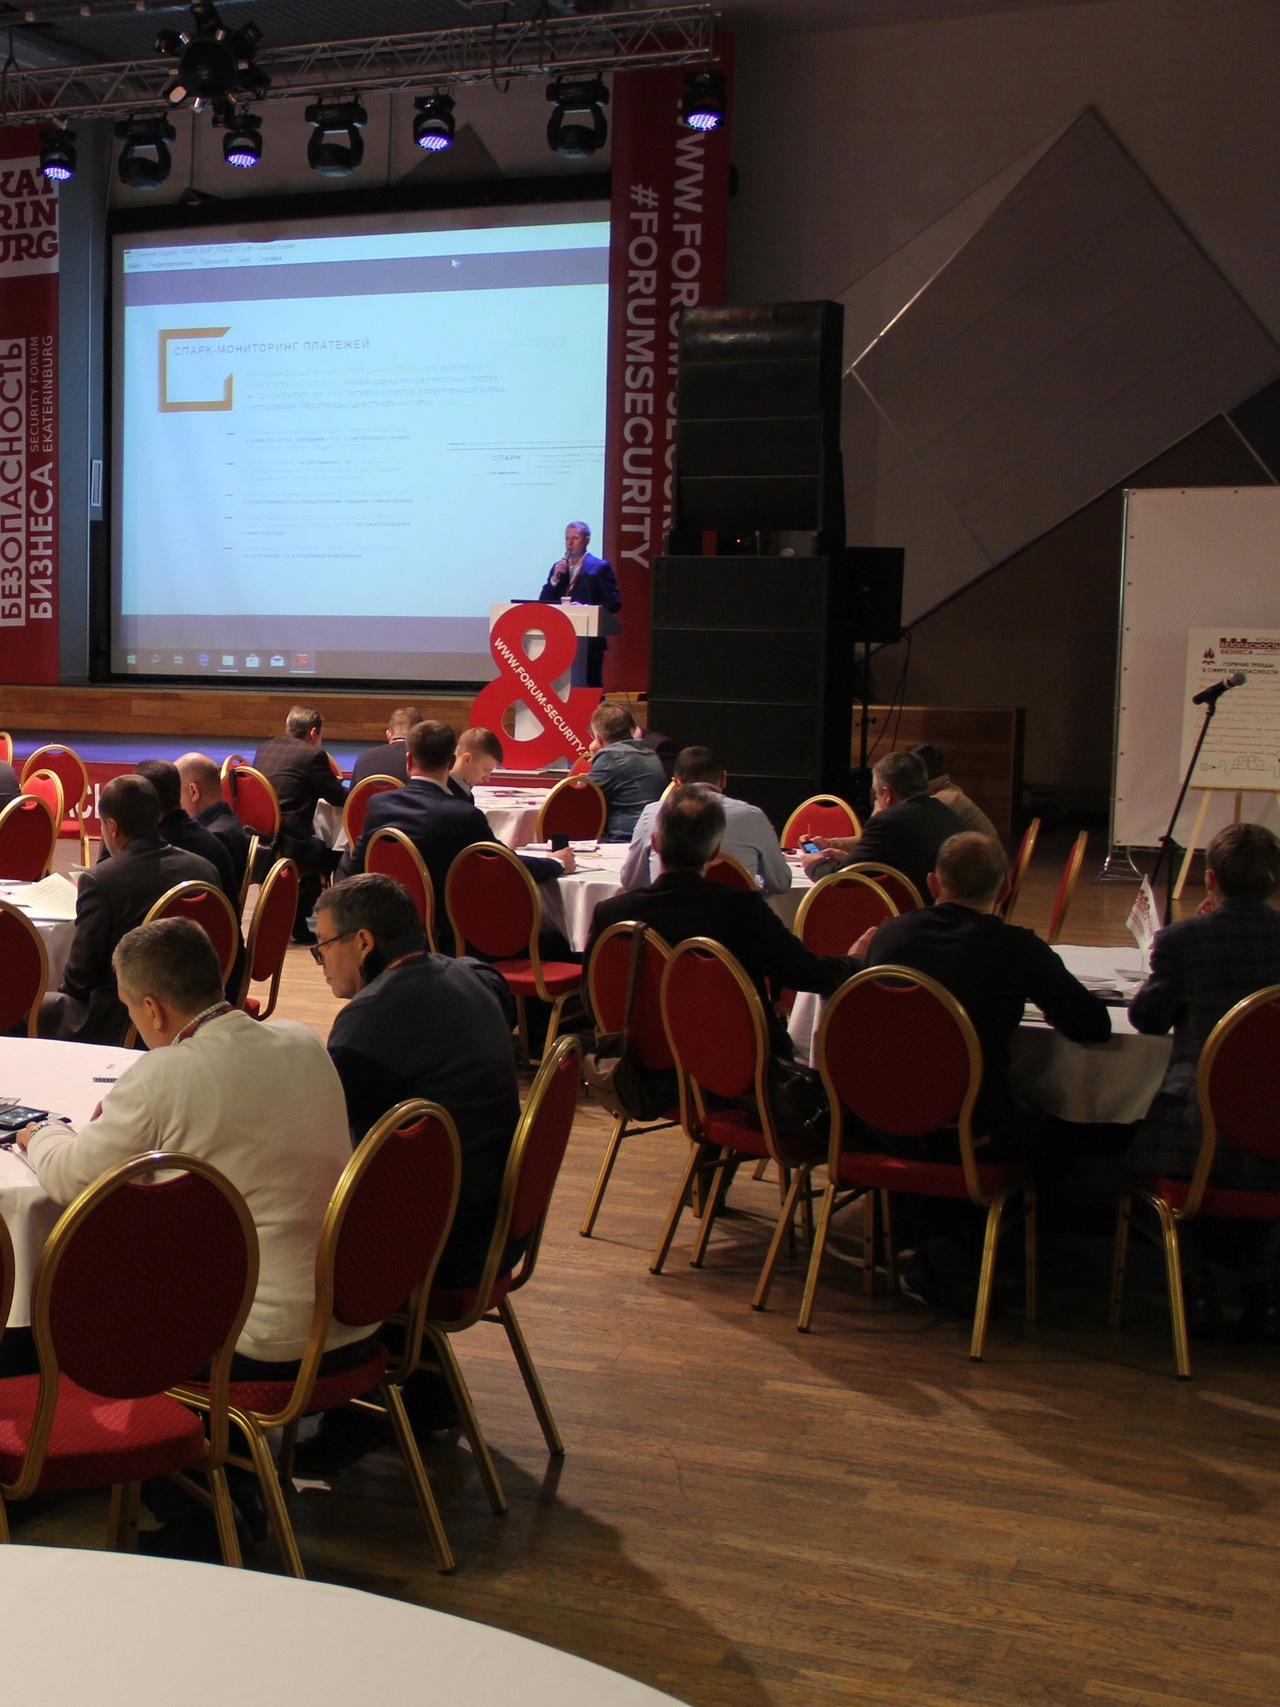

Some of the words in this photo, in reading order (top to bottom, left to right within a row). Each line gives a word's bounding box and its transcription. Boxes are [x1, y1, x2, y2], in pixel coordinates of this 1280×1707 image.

[30, 336, 39, 383] FORUM
[42, 335, 53, 453] EKATERINBURG
[173, 342, 299, 356] СПАРК-МОНИТОРИНГ
[303, 338, 370, 351] ПЛАТЕЖЕЙ
[620, 183, 659, 569] #FORUMSECURITY
[30, 389, 39, 452] SECURITY
[0, 343, 23, 619] БЕЗОПАСНОСТЬ
[29, 462, 53, 619] БИЗНЕСА
